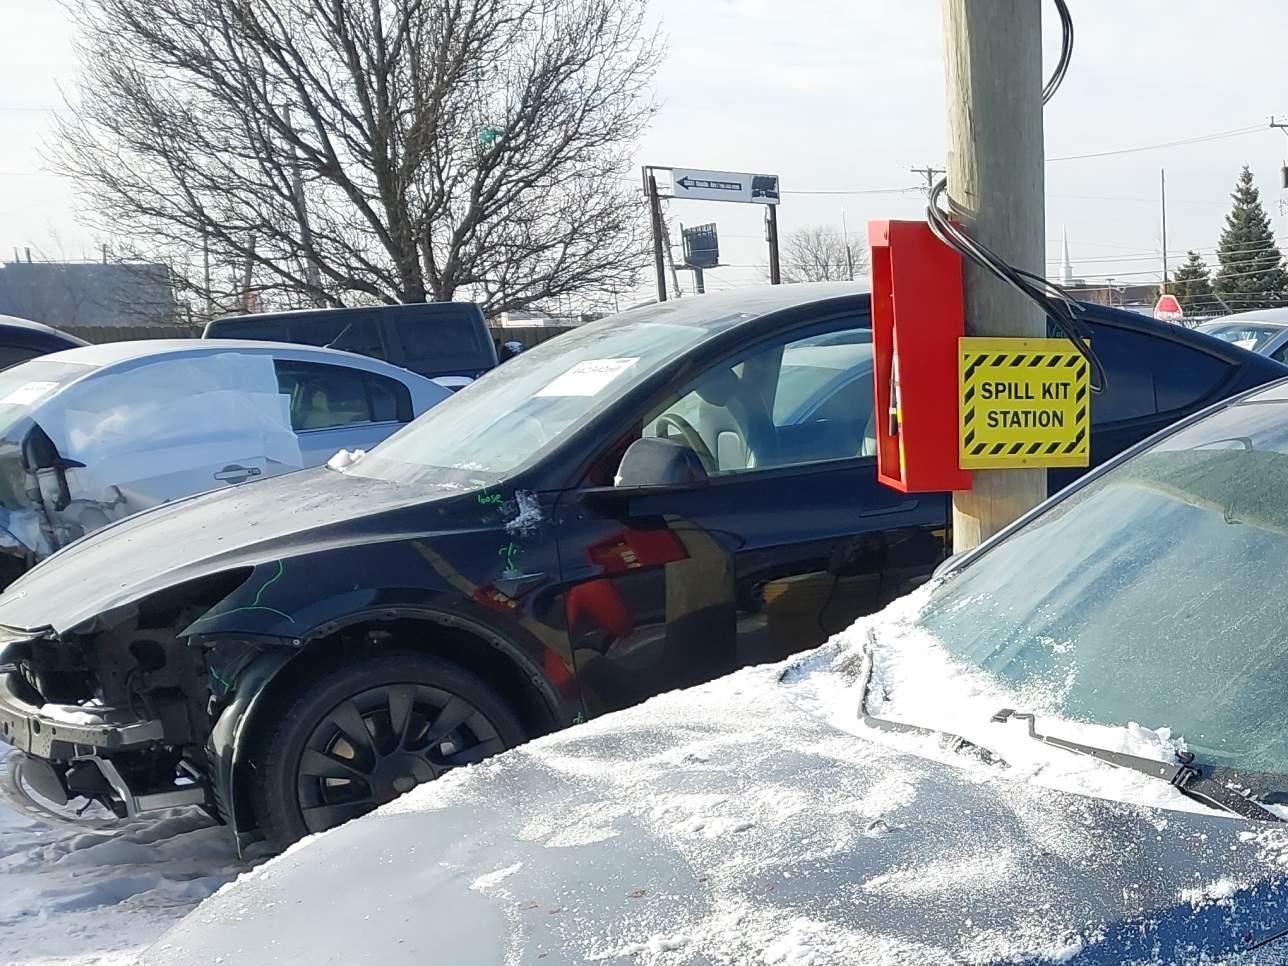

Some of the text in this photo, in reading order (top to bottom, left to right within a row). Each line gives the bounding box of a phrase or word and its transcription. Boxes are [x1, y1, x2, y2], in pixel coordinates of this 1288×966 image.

[981, 382, 1071, 400] SPILL KIT
[987, 410, 1064, 428] STATION
